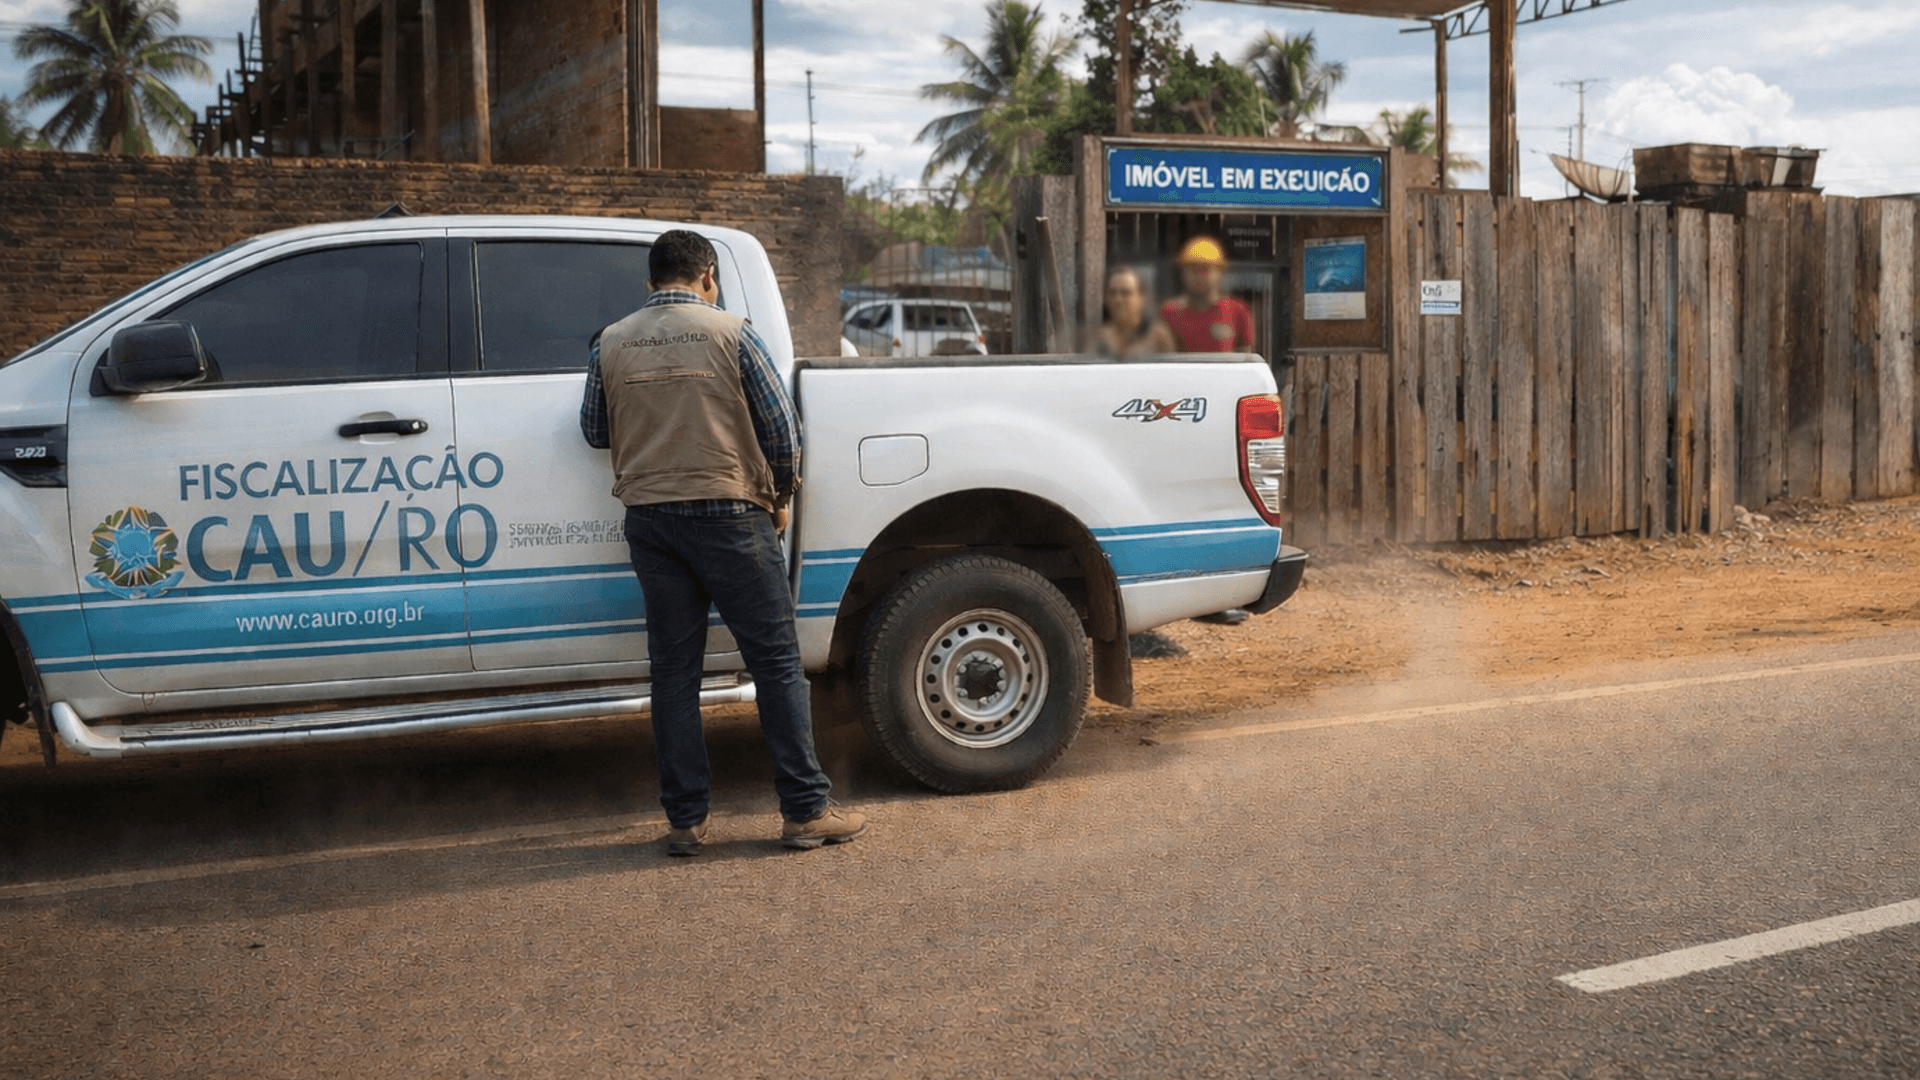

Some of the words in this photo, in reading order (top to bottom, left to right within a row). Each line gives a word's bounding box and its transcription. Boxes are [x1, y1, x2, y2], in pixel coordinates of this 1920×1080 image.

[1124, 160, 1215, 189] IMÓVEL
[1221, 166, 1255, 190] EM
[235, 600, 424, 633] www.cauro.org.br
